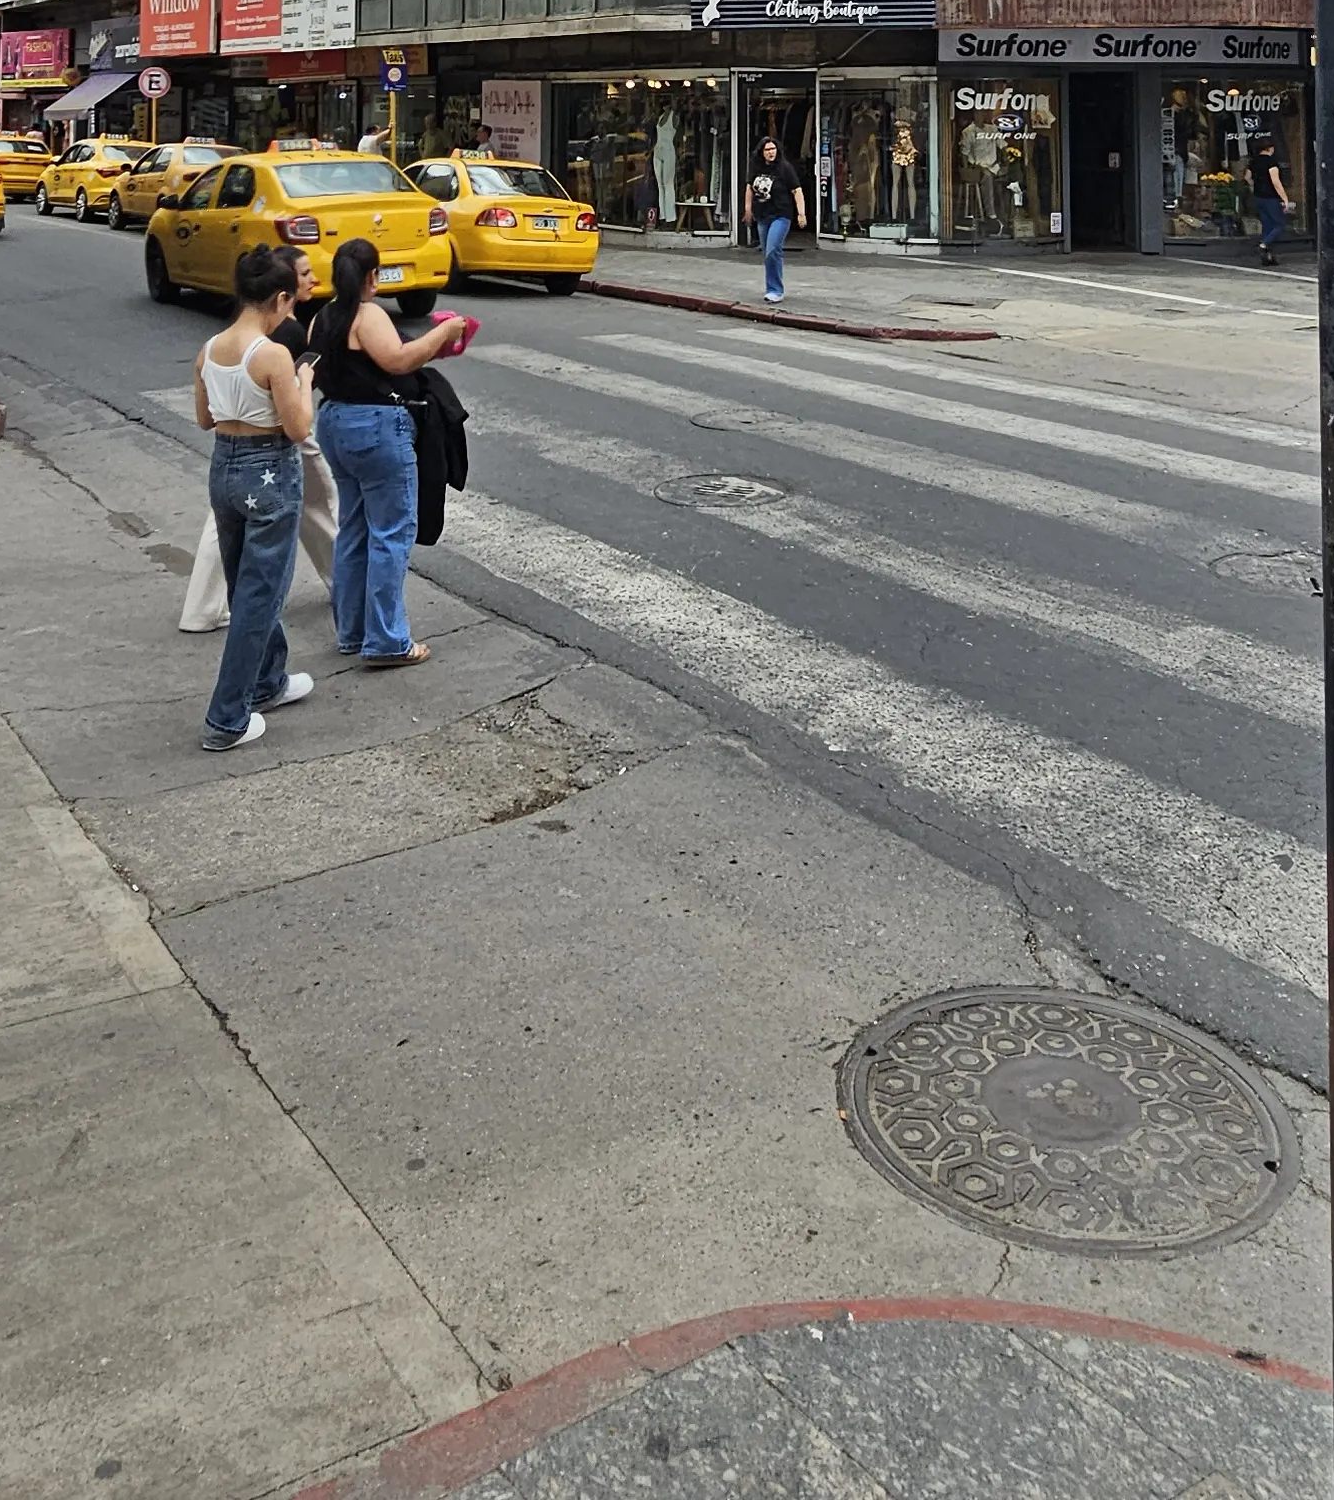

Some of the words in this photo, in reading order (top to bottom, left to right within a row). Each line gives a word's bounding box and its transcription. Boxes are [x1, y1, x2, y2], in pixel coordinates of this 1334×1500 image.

[765, 0, 821, 24] Clothing
[823, 0, 879, 25] Boutique
[956, 33, 1067, 57] Surfone
[1093, 33, 1197, 57] Surfone
[1222, 35, 1290, 59] Surfone
[385, 51, 404, 63] Taxis
[149, 74, 161, 91] E
[955, 88, 1049, 111] Surfon
[1206, 89, 1281, 112] Surfone
[975, 132, 1012, 140] SURF
[1013, 132, 1037, 140] ONE
[1227, 132, 1253, 140] SURF
[1254, 131, 1271, 140] ONE
